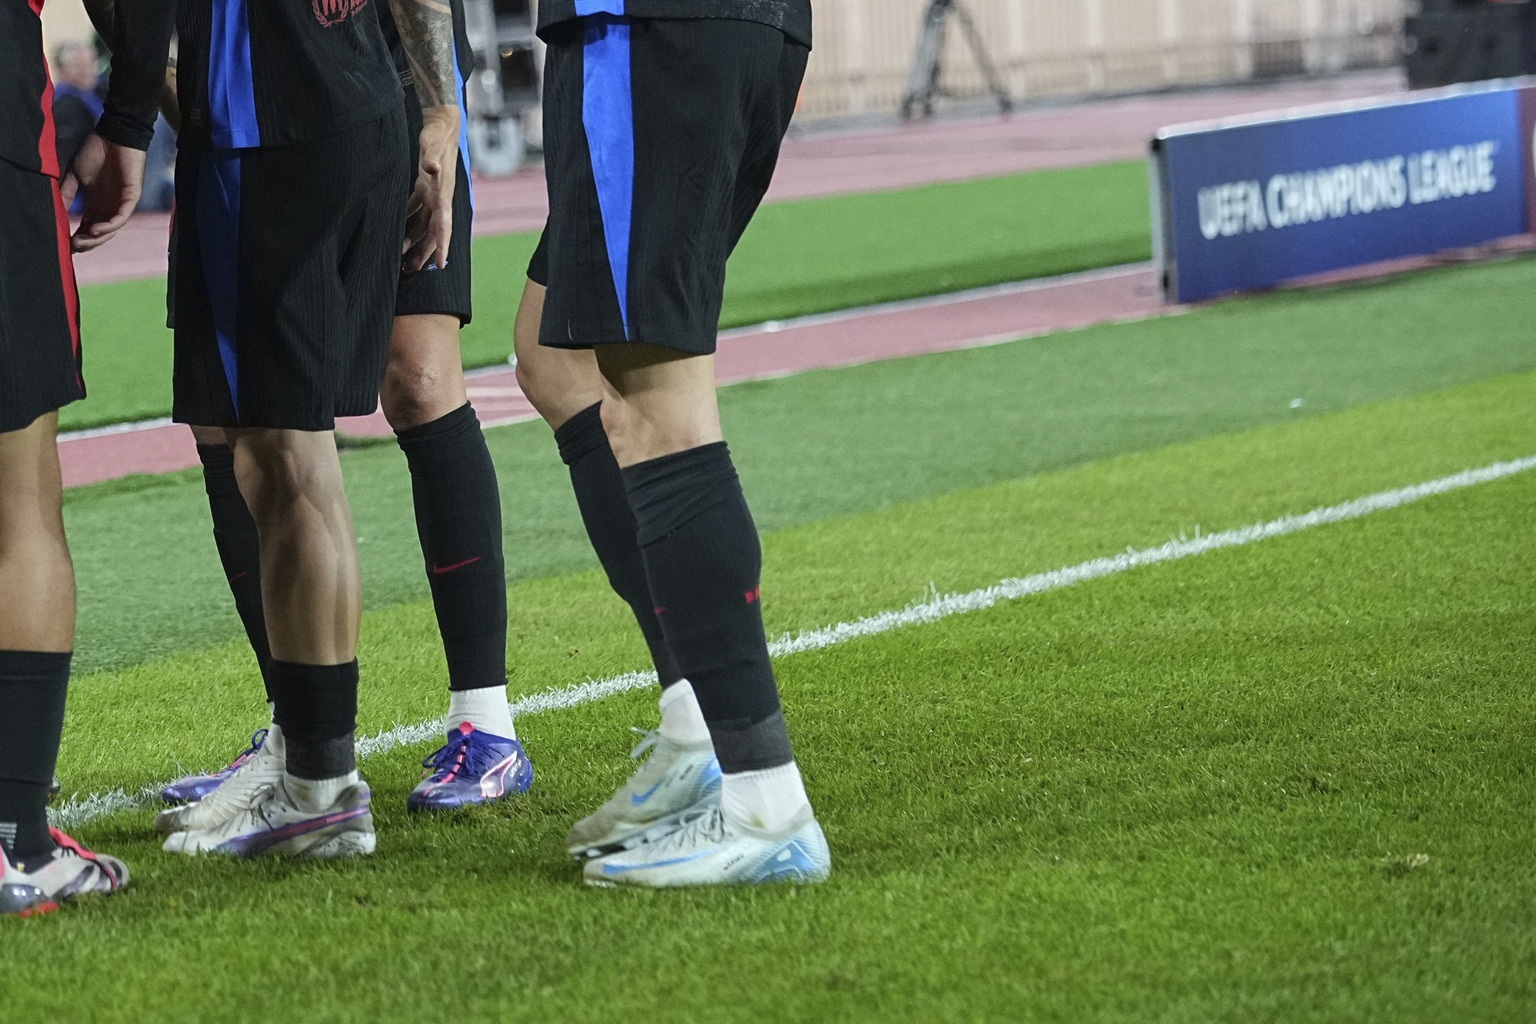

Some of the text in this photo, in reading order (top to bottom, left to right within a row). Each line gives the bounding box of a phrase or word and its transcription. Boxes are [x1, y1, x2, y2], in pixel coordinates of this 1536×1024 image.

[1197, 140, 1498, 240] UEFA CHAMPIONS LEAGUE
